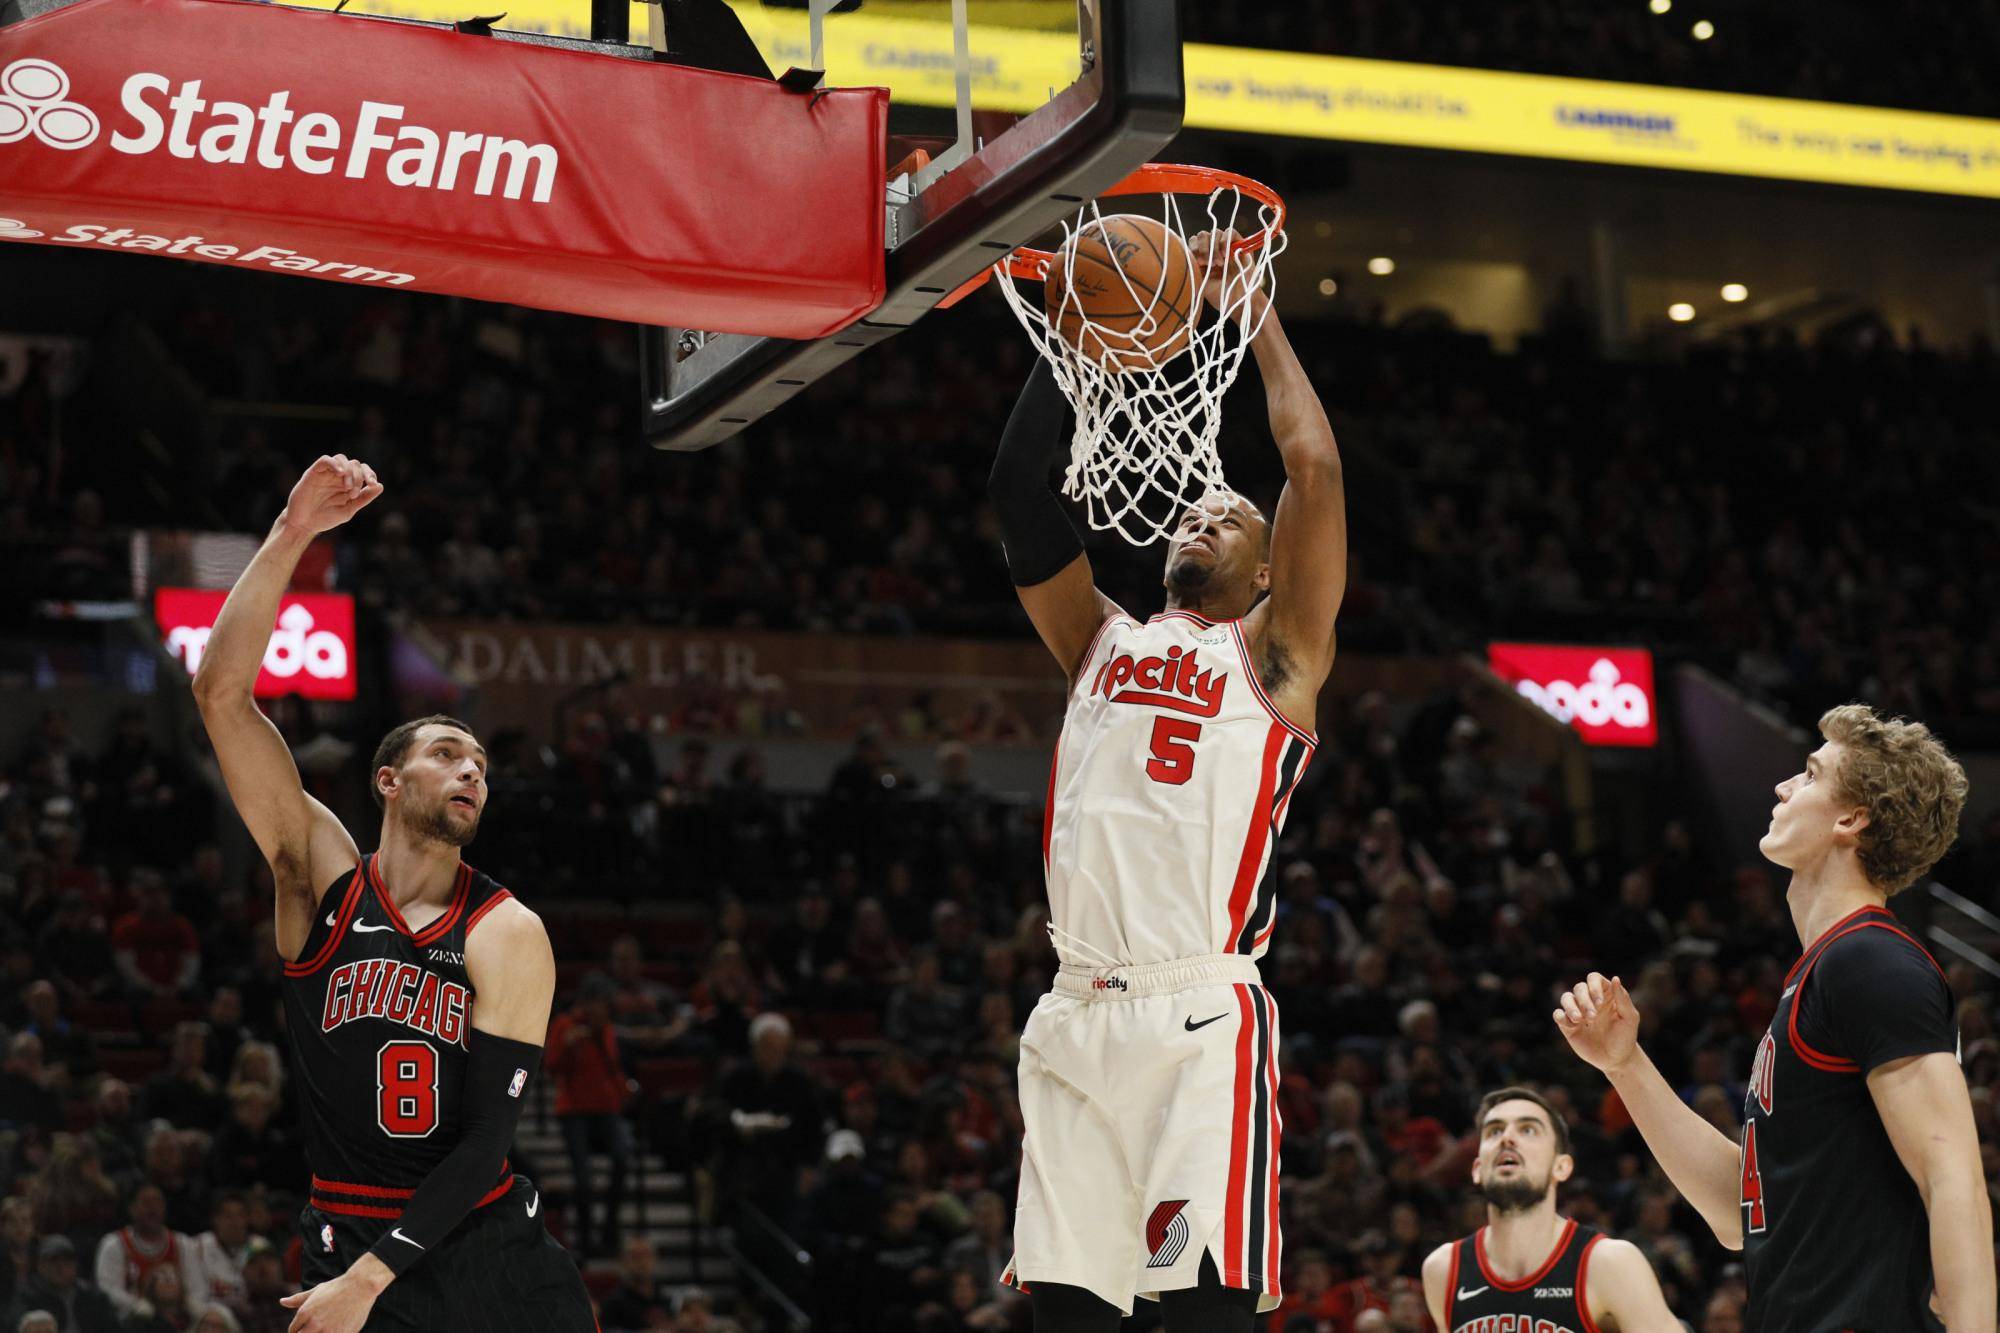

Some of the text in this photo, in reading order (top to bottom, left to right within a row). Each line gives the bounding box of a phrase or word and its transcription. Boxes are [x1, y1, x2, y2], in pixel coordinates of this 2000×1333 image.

[165, 603, 348, 679] mda
[458, 630, 776, 692] DAIMLER
[1515, 657, 1650, 728] oda
[1145, 714, 1203, 786] 5
[1092, 976, 1128, 993] ripcity
[376, 1039, 440, 1139] 8
